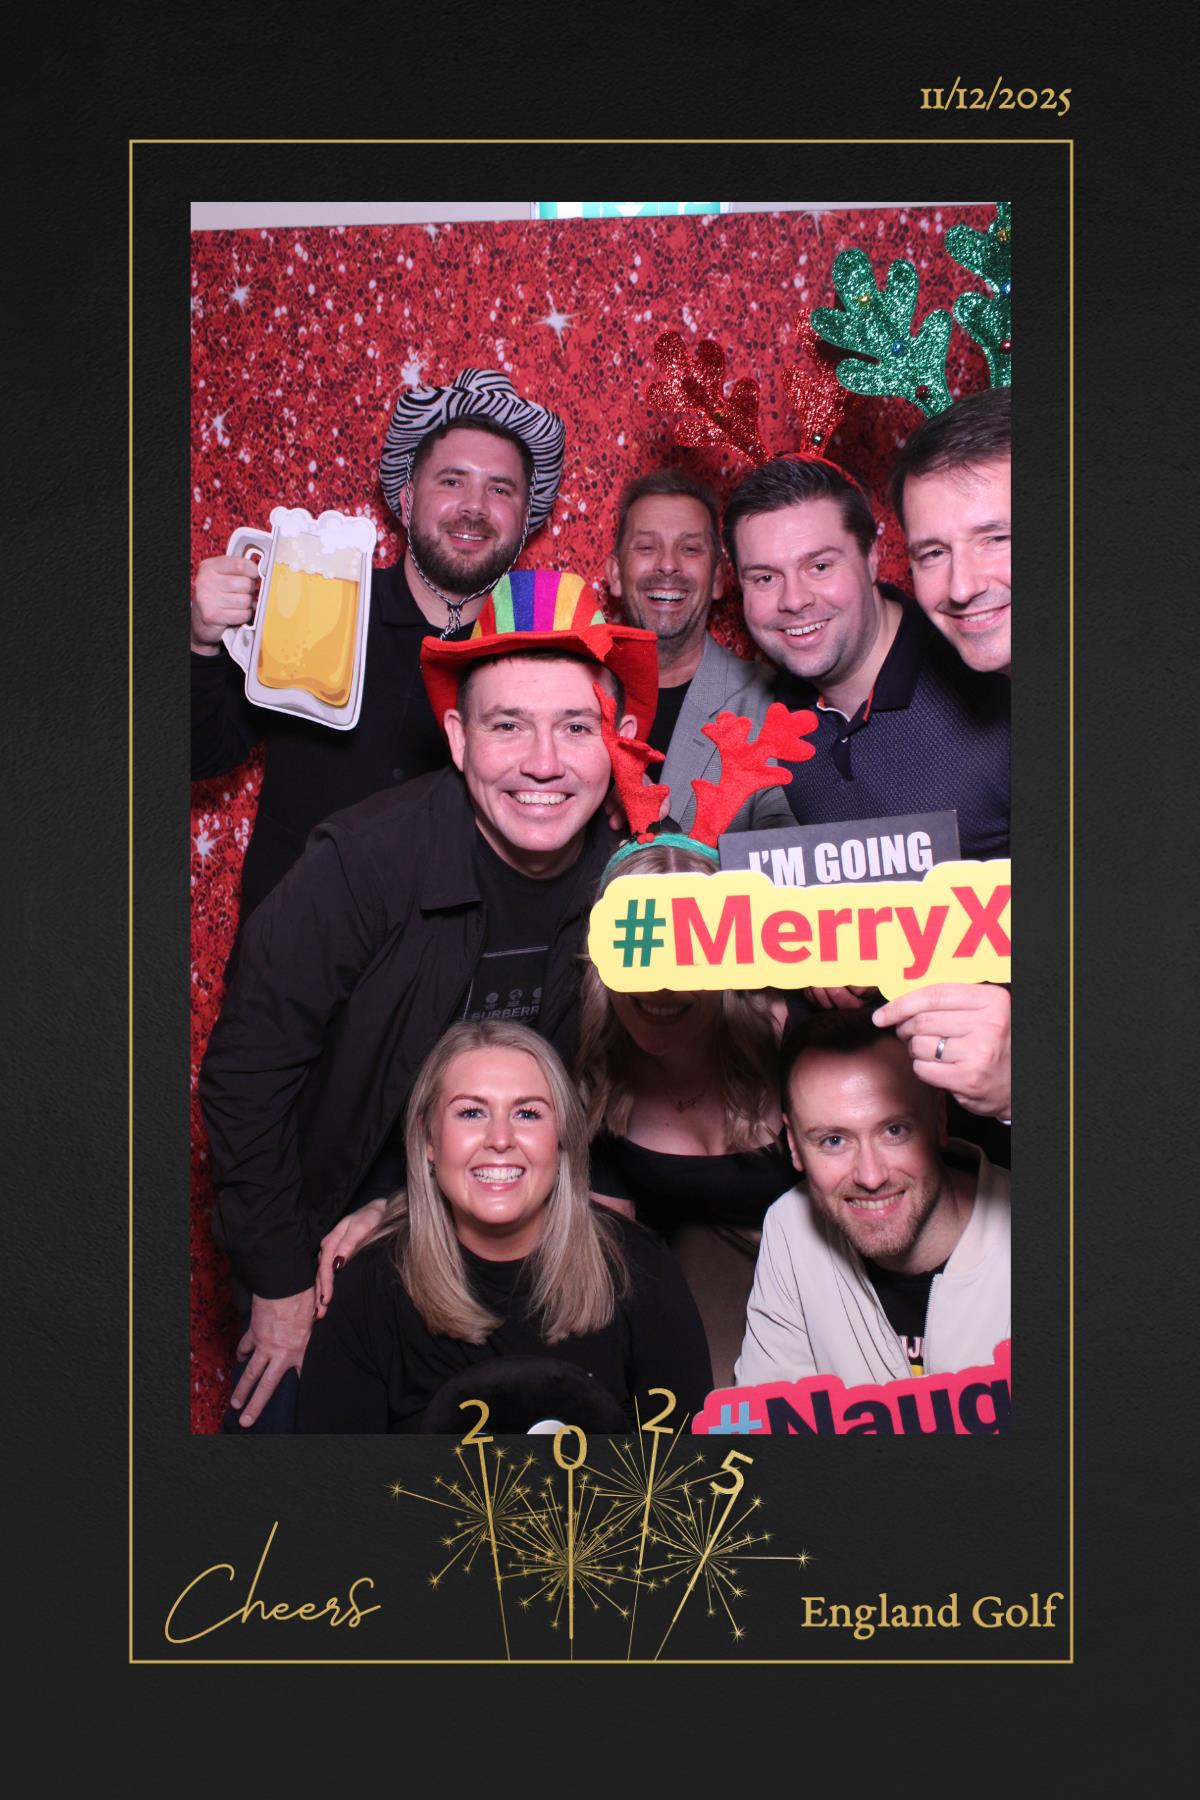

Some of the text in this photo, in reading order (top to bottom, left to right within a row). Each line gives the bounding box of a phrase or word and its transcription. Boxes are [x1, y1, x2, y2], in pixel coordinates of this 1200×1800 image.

[748, 831, 935, 887] I'M GOING
[612, 884, 1011, 981] #MerryX
